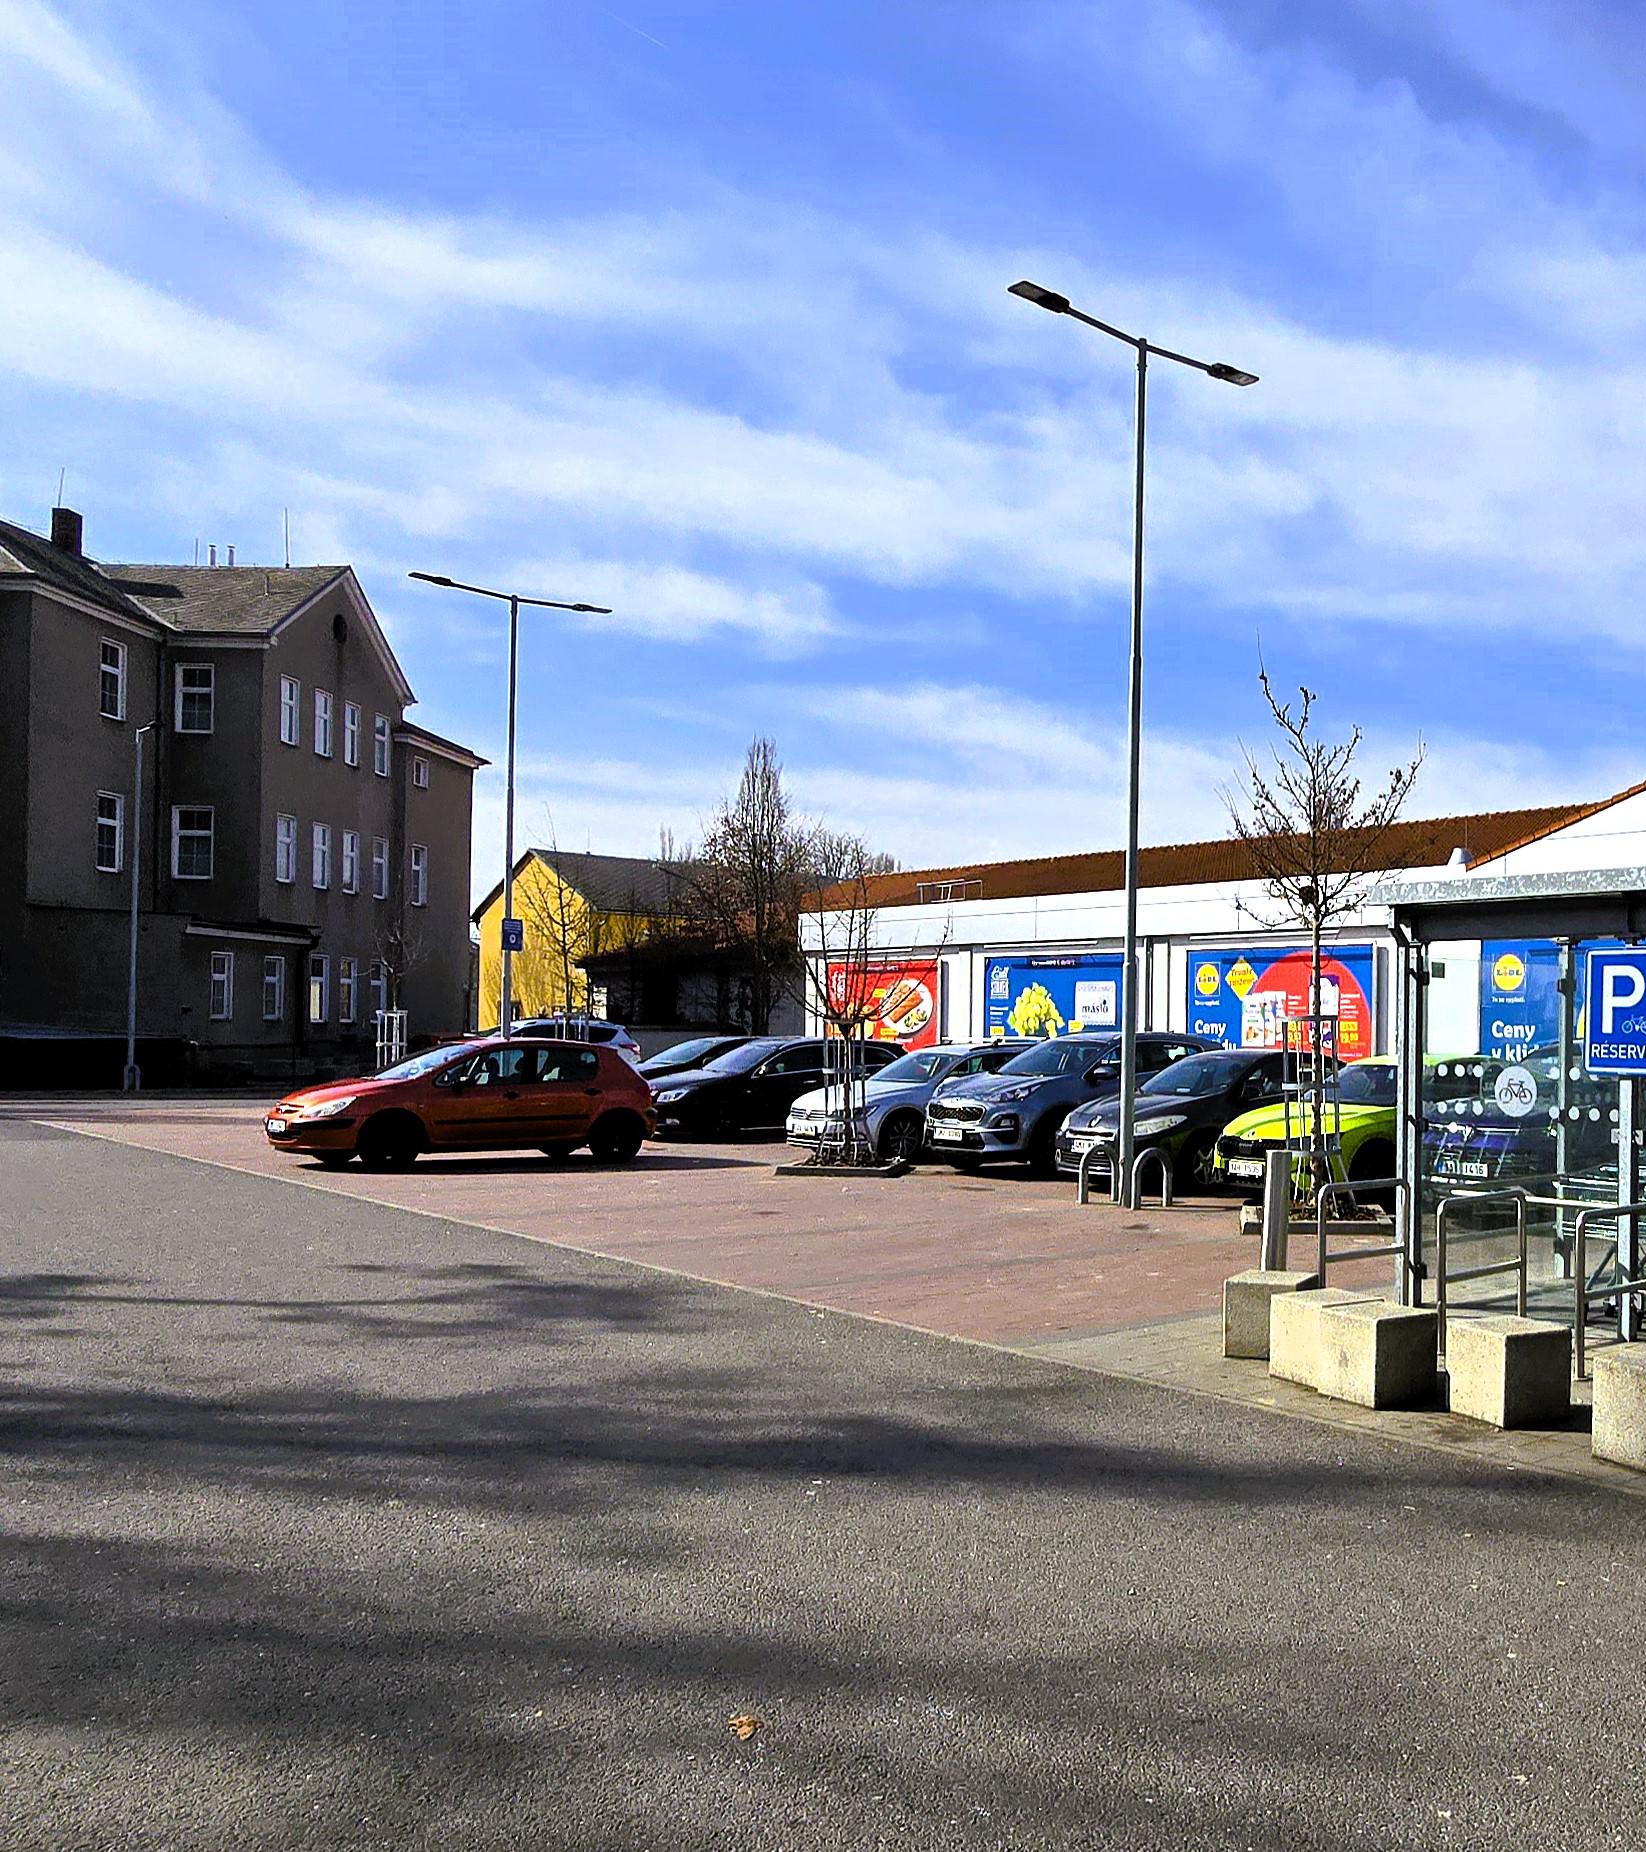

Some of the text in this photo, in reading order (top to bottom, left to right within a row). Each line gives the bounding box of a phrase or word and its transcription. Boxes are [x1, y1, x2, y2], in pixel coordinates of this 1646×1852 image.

[1601, 964, 1646, 1034] P
[1194, 1019, 1227, 1038] Ceny
[1491, 1020, 1536, 1041] Ceny
